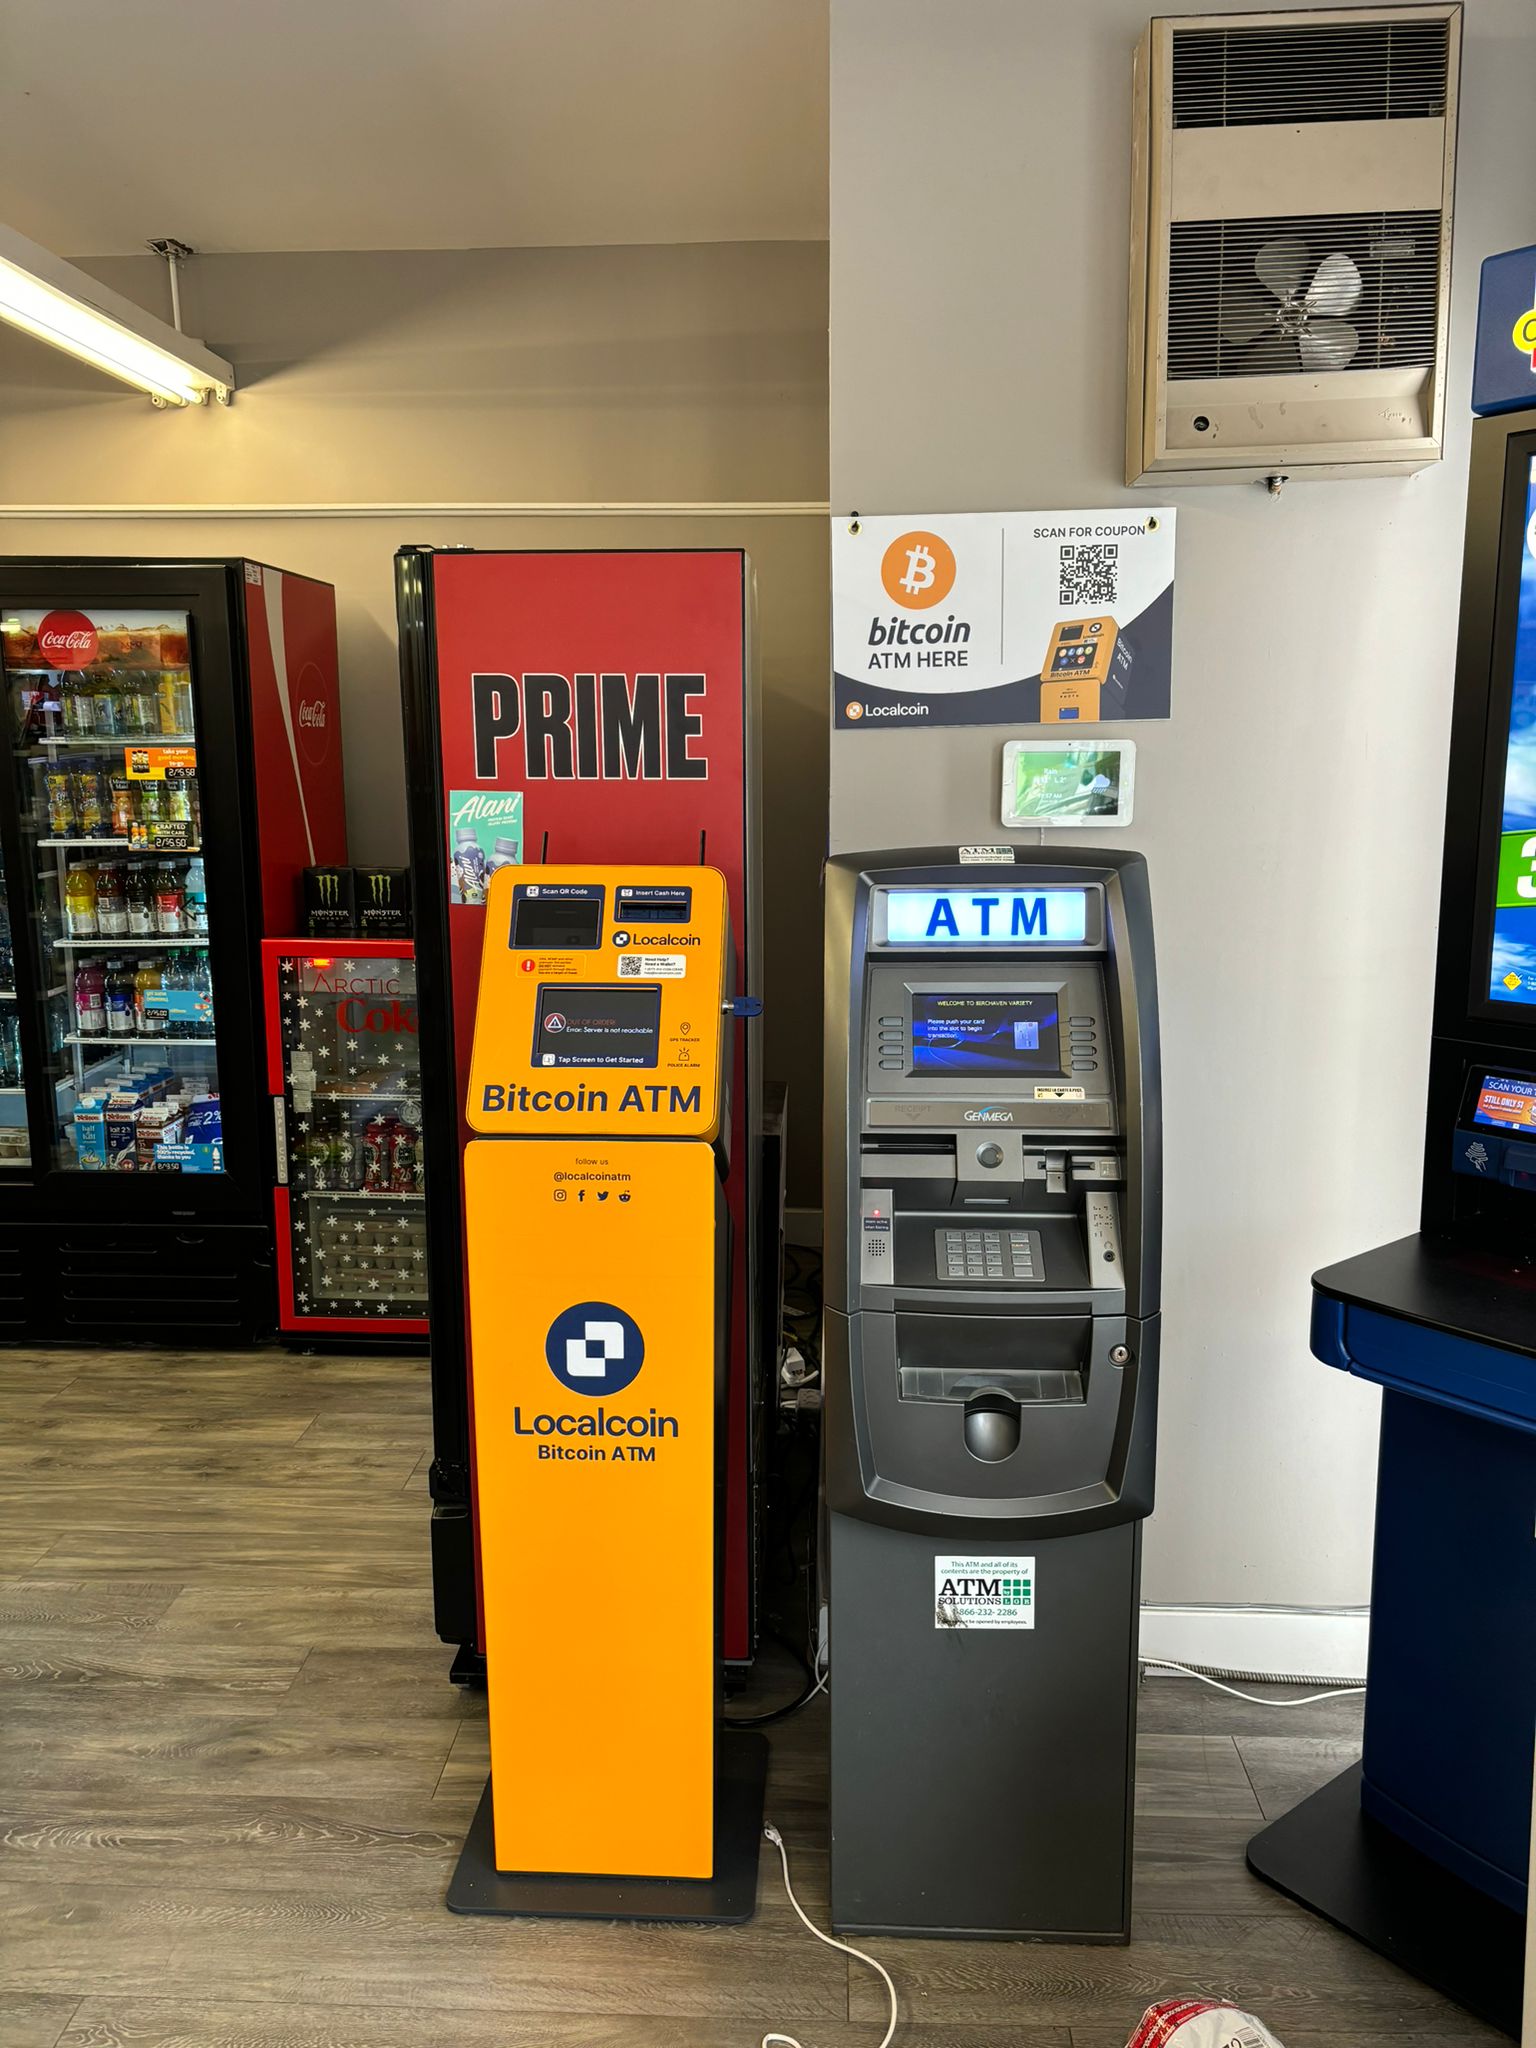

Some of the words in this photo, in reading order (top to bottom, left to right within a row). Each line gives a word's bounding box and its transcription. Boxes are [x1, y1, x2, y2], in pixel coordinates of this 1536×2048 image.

[1033, 527, 1067, 539] SCAN
[1068, 527, 1093, 538] FOR
[1094, 525, 1146, 537] COUPON
[868, 615, 971, 646] bitcoin
[41, 630, 94, 649] Coca-Cola
[868, 652, 913, 670] ATM
[917, 651, 969, 668] HERE
[1050, 670, 1073, 678] Bitcoin
[865, 702, 929, 717] Localcoin
[471, 672, 709, 781] PRIME
[451, 792, 522, 827] Alani
[541, 888, 558, 896] Scan
[559, 888, 570, 896] QR
[571, 888, 588, 896] Code
[311, 908, 350, 917] MONSTER
[363, 908, 402, 917] MONSTER
[925, 897, 1048, 937] ATM
[632, 933, 701, 947] Localcoin
[311, 973, 401, 995] ARCTIC
[336, 997, 418, 1034] Cok
[566, 1018, 582, 1026] OUT
[582, 1018, 592, 1026] OF
[566, 1026, 583, 1034] Error:
[584, 1026, 603, 1034] Server
[610, 1026, 621, 1034] not
[621, 1027, 654, 1035] reachable
[558, 1056, 571, 1065] Tap
[572, 1056, 596, 1064] Screen
[596, 1056, 604, 1064] to
[605, 1056, 618, 1064] Get
[618, 1056, 644, 1064] Started
[1488, 1081, 1509, 1092] SCAN
[1511, 1085, 1533, 1096] YOUR
[482, 1082, 608, 1113] Bitcoin
[618, 1085, 702, 1113] ATM
[1483, 1095, 1501, 1105] STILL
[1501, 1097, 1518, 1108] ONLY
[895, 1105, 932, 1113] RECEIPT
[964, 1110, 1014, 1122] GENMEGA
[575, 1157, 598, 1166] follow
[553, 1171, 632, 1183] @localcoinatm
[513, 1405, 679, 1438] Localcoin
[537, 1444, 606, 1461] Bitcoin
[611, 1446, 656, 1462] ATM
[992, 1568, 1020, 1576] property
[938, 1578, 1002, 1597] ATM
[938, 1596, 1002, 1606] SOLUTIONS
[997, 1608, 1018, 1616] 2286
